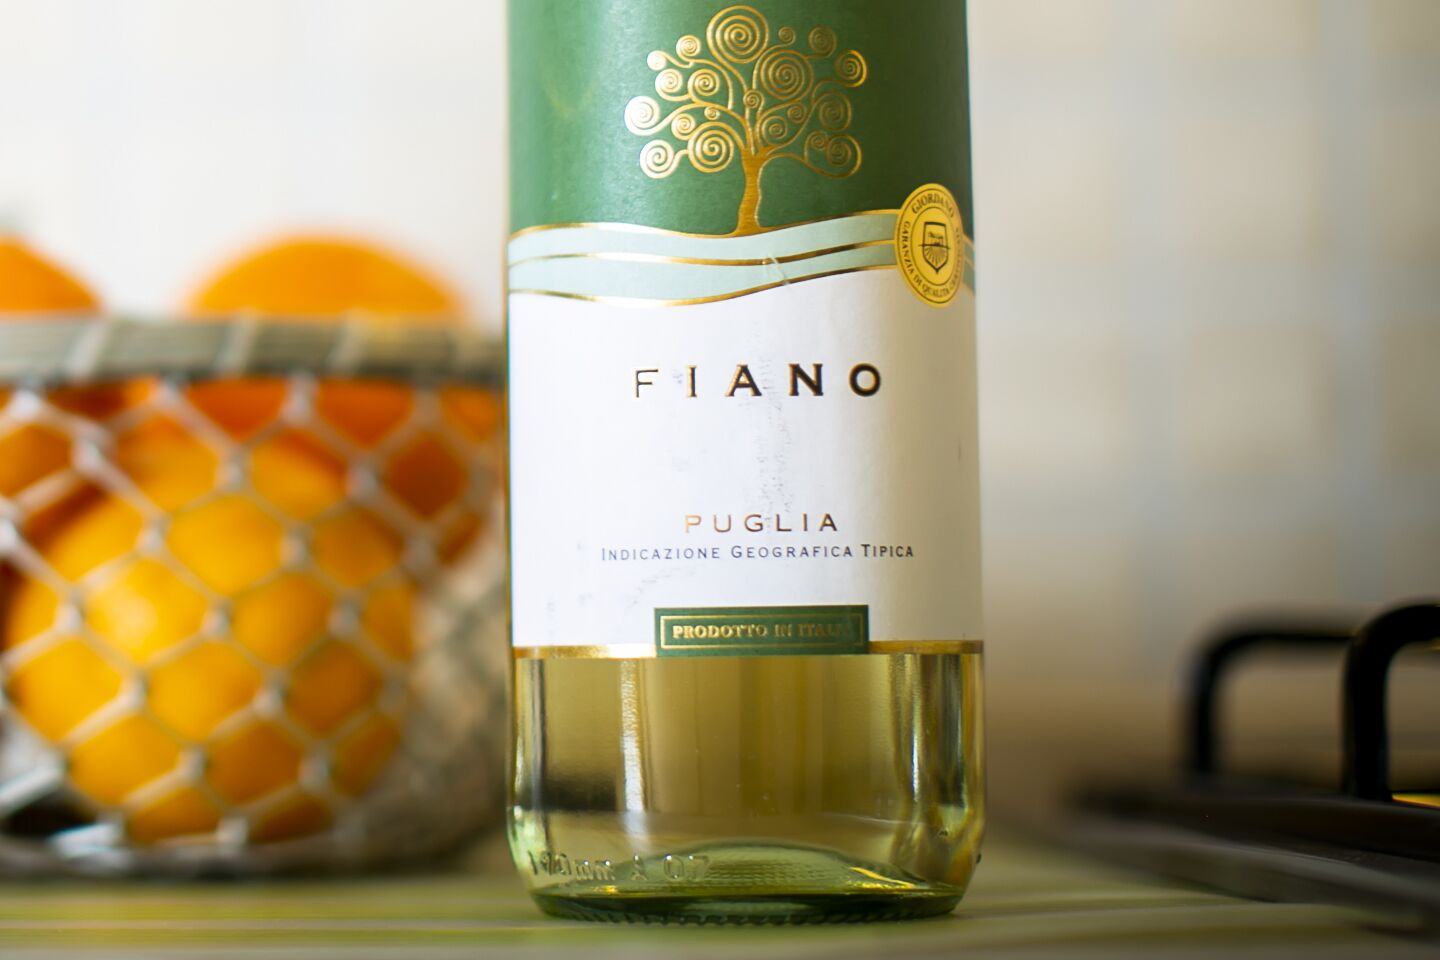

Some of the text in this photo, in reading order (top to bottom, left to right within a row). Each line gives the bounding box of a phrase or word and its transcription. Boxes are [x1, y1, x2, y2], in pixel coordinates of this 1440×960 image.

[634, 362, 882, 398] FIANO
[684, 512, 838, 534] PUGLIA
[601, 543, 915, 562] INDICAZIONE GEOGRAFICA TIPICA
[672, 623, 769, 640] PRODOTTO
[773, 623, 793, 639] IN
